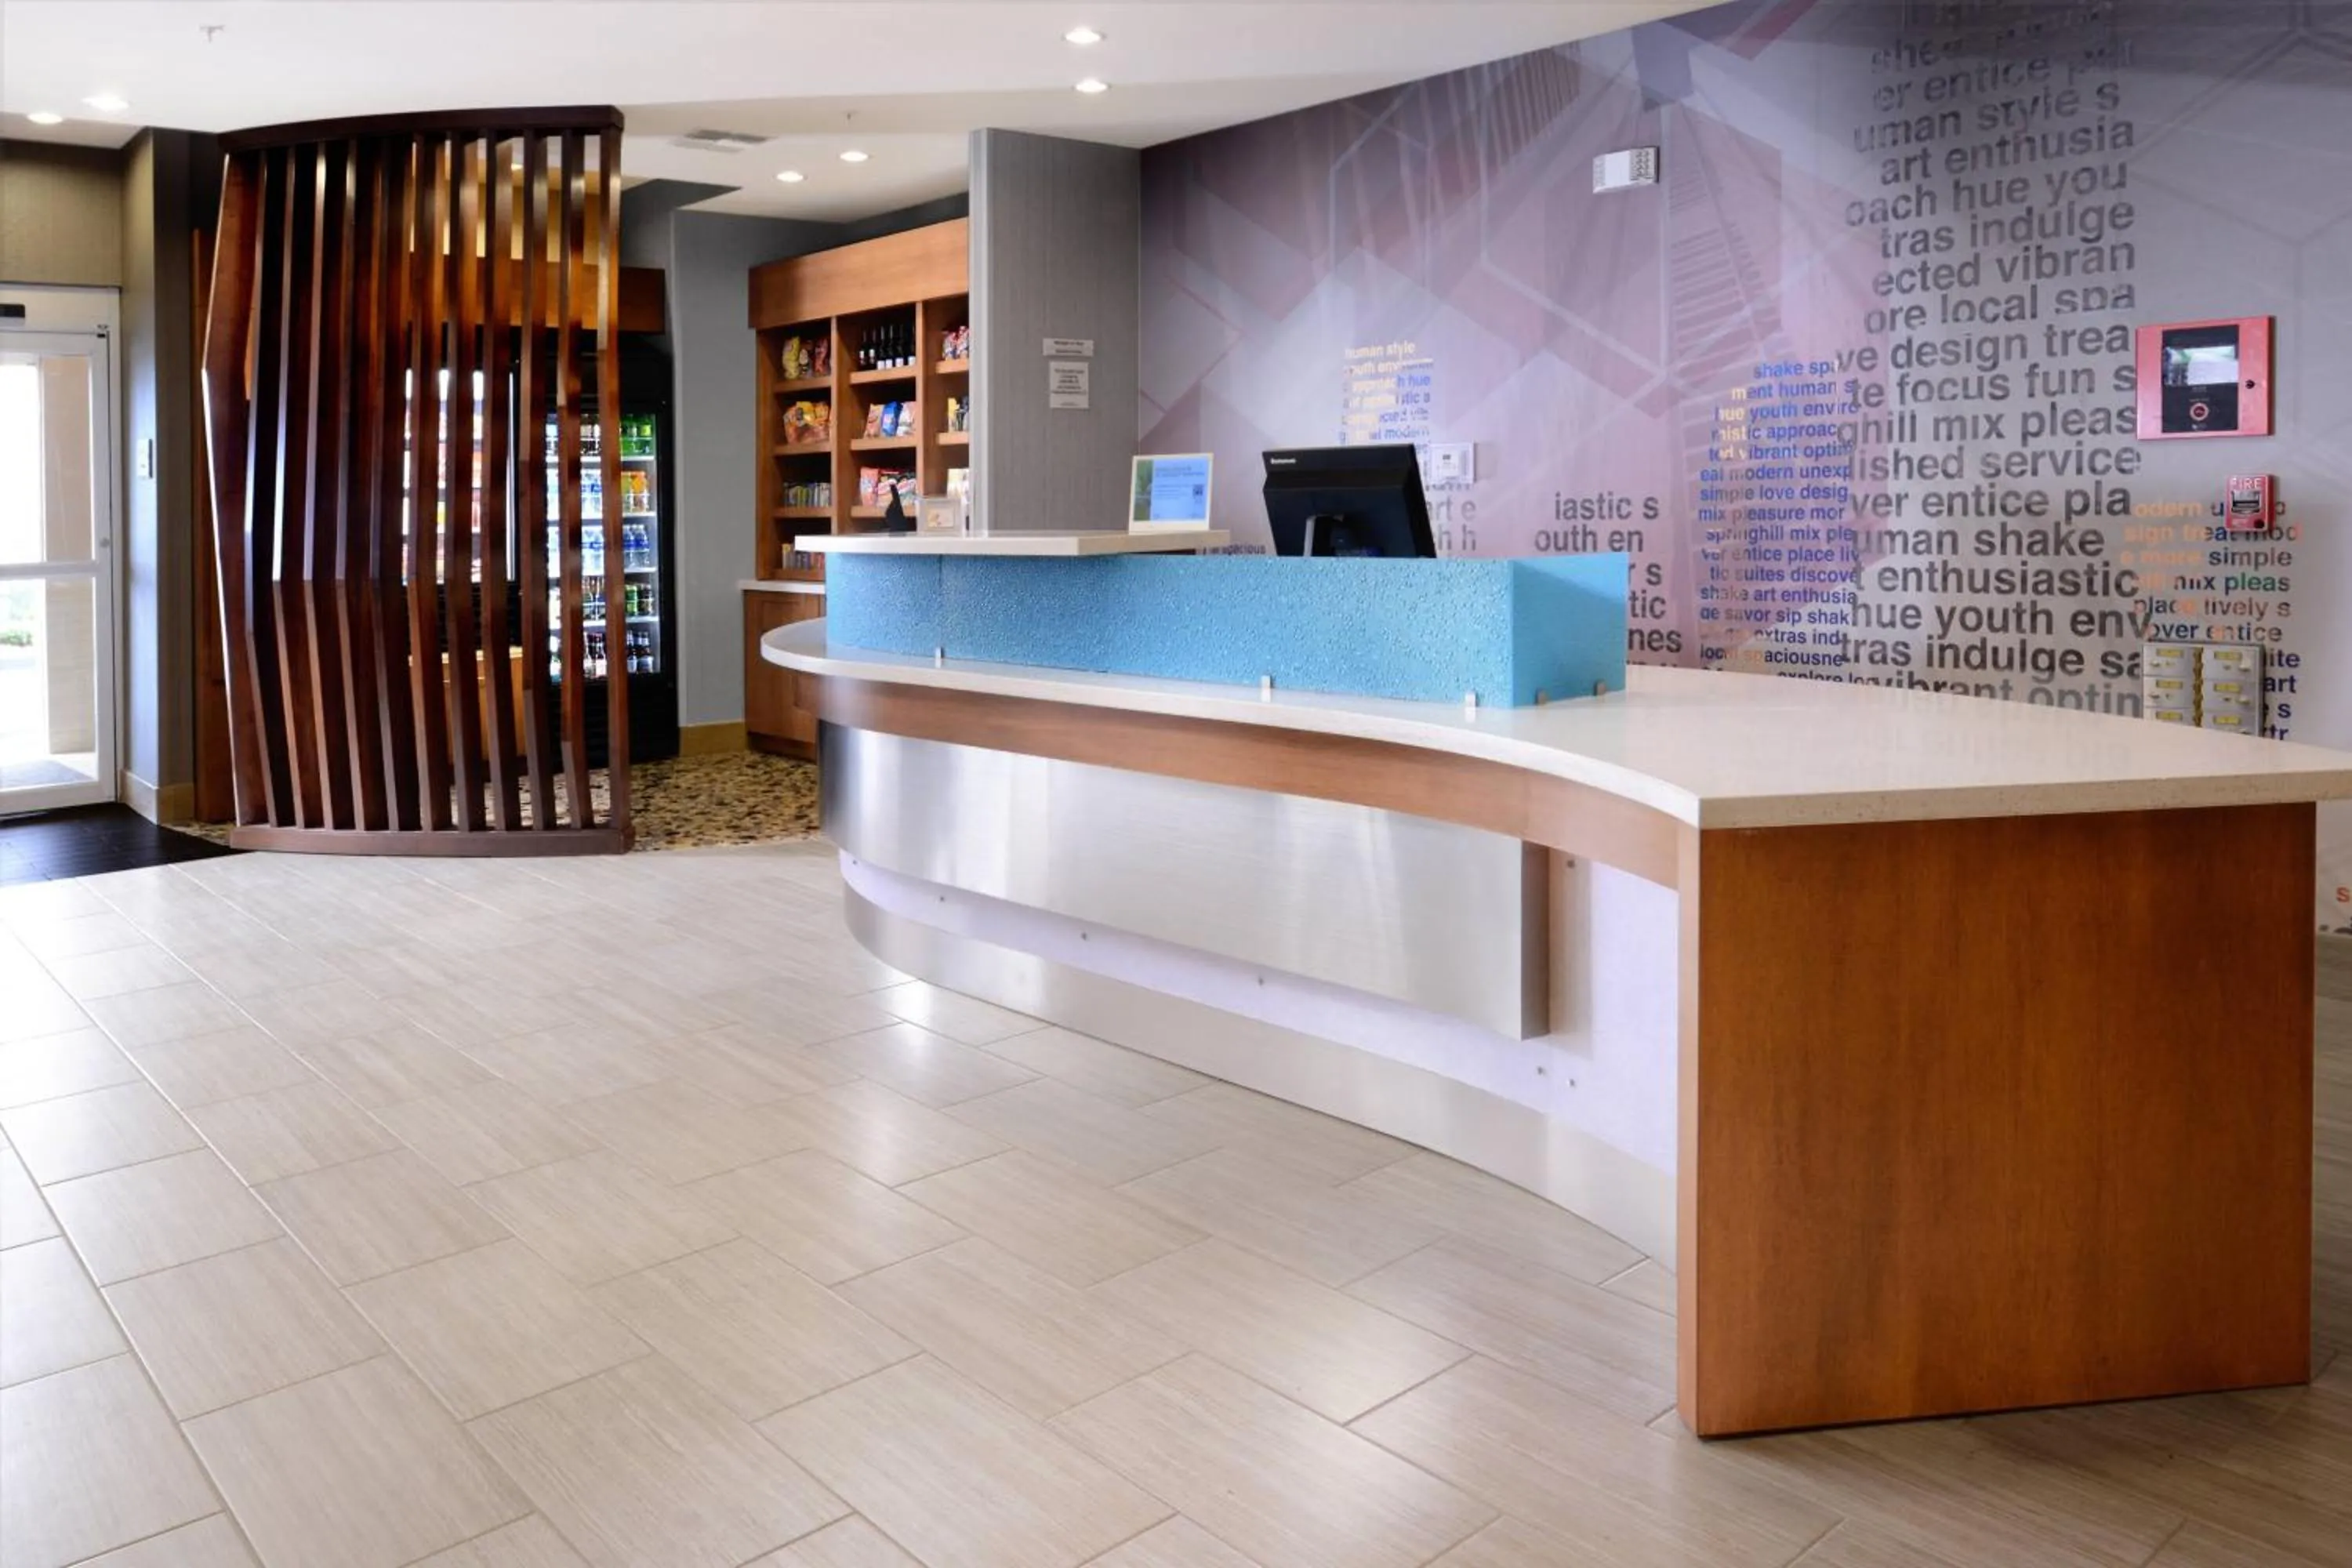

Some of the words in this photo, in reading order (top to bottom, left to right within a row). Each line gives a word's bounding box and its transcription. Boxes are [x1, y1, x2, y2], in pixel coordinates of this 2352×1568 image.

[1873, 80, 1911, 111] er
[1923, 56, 2051, 103] entice
[1853, 109, 1962, 153] uman
[1976, 86, 2080, 132] style
[2096, 81, 2121, 111] s
[1881, 147, 1932, 185] art
[1945, 116, 2134, 173] enthusia
[1845, 184, 1936, 227] oach
[1953, 176, 2030, 212] hue
[2044, 162, 2127, 207] you
[1881, 225, 1955, 259] tras
[1969, 201, 2135, 248] indulge
[1872, 252, 1980, 296] ected
[1995, 241, 2135, 283] vibran
[1864, 303, 1927, 334] ore
[1940, 284, 2038, 324] local
[1836, 347, 1878, 372] ve
[1890, 333, 2027, 372] design
[2042, 324, 2130, 358] trea
[1754, 360, 1802, 379] shake
[1731, 382, 1773, 400] ment
[1778, 380, 1837, 397] human
[1851, 378, 1884, 408] te
[1896, 372, 2010, 405] focus
[2024, 363, 2096, 398] fun
[2112, 364, 2136, 392] s
[1750, 401, 1797, 423] youth
[1766, 423, 1836, 442] approac
[1835, 409, 1917, 452] ghill
[1932, 412, 2005, 442] mix
[2021, 401, 2136, 447] pleas
[1738, 443, 1799, 460] vibrant
[1847, 445, 1965, 483] lished
[1979, 441, 2137, 480] service
[1730, 465, 1793, 481] modern
[1800, 465, 1853, 482] unexp
[2229, 477, 2263, 490] FIRE
[1700, 485, 1755, 503] simple
[1760, 485, 1795, 500] love
[1800, 483, 1848, 503] desig
[1851, 492, 1909, 518] ver
[1922, 483, 2049, 517] entice
[2063, 481, 2132, 524] pla
[1555, 492, 1632, 520] iastic
[1642, 496, 1659, 520] s
[1699, 506, 1725, 521] mix
[1732, 506, 1805, 525] pleasure
[1810, 506, 1844, 520] mor
[1534, 524, 1598, 552] outh
[1608, 529, 1643, 552] en
[1790, 525, 1820, 540] mix
[1827, 525, 1855, 543] ple
[1853, 528, 1959, 555] uman
[1973, 521, 2105, 557] shake
[1732, 547, 1783, 562] entice
[1788, 547, 1835, 564] place
[1840, 547, 1860, 562] liv
[2209, 546, 2292, 572] simple
[1646, 562, 1662, 586] s
[1734, 567, 1784, 582] suites
[1791, 566, 1859, 583] discove
[1878, 561, 2140, 597] enthusiastic
[2224, 572, 2291, 596] pleas
[1700, 585, 1749, 601] shake
[1753, 588, 1776, 602] art
[1781, 587, 1857, 604] enthusia
[1726, 609, 1771, 622] savor
[1776, 608, 1802, 626] sip
[1807, 608, 1850, 625] shak
[1851, 597, 1923, 630] hue
[1934, 601, 2054, 640] youth
[2070, 608, 2153, 639] env
[2205, 597, 2269, 621] lively
[2277, 601, 2291, 617] s
[1813, 628, 1840, 645] ind
[2206, 622, 2283, 641] entice
[1840, 633, 1912, 666] tras
[1926, 634, 2085, 684] indulge
